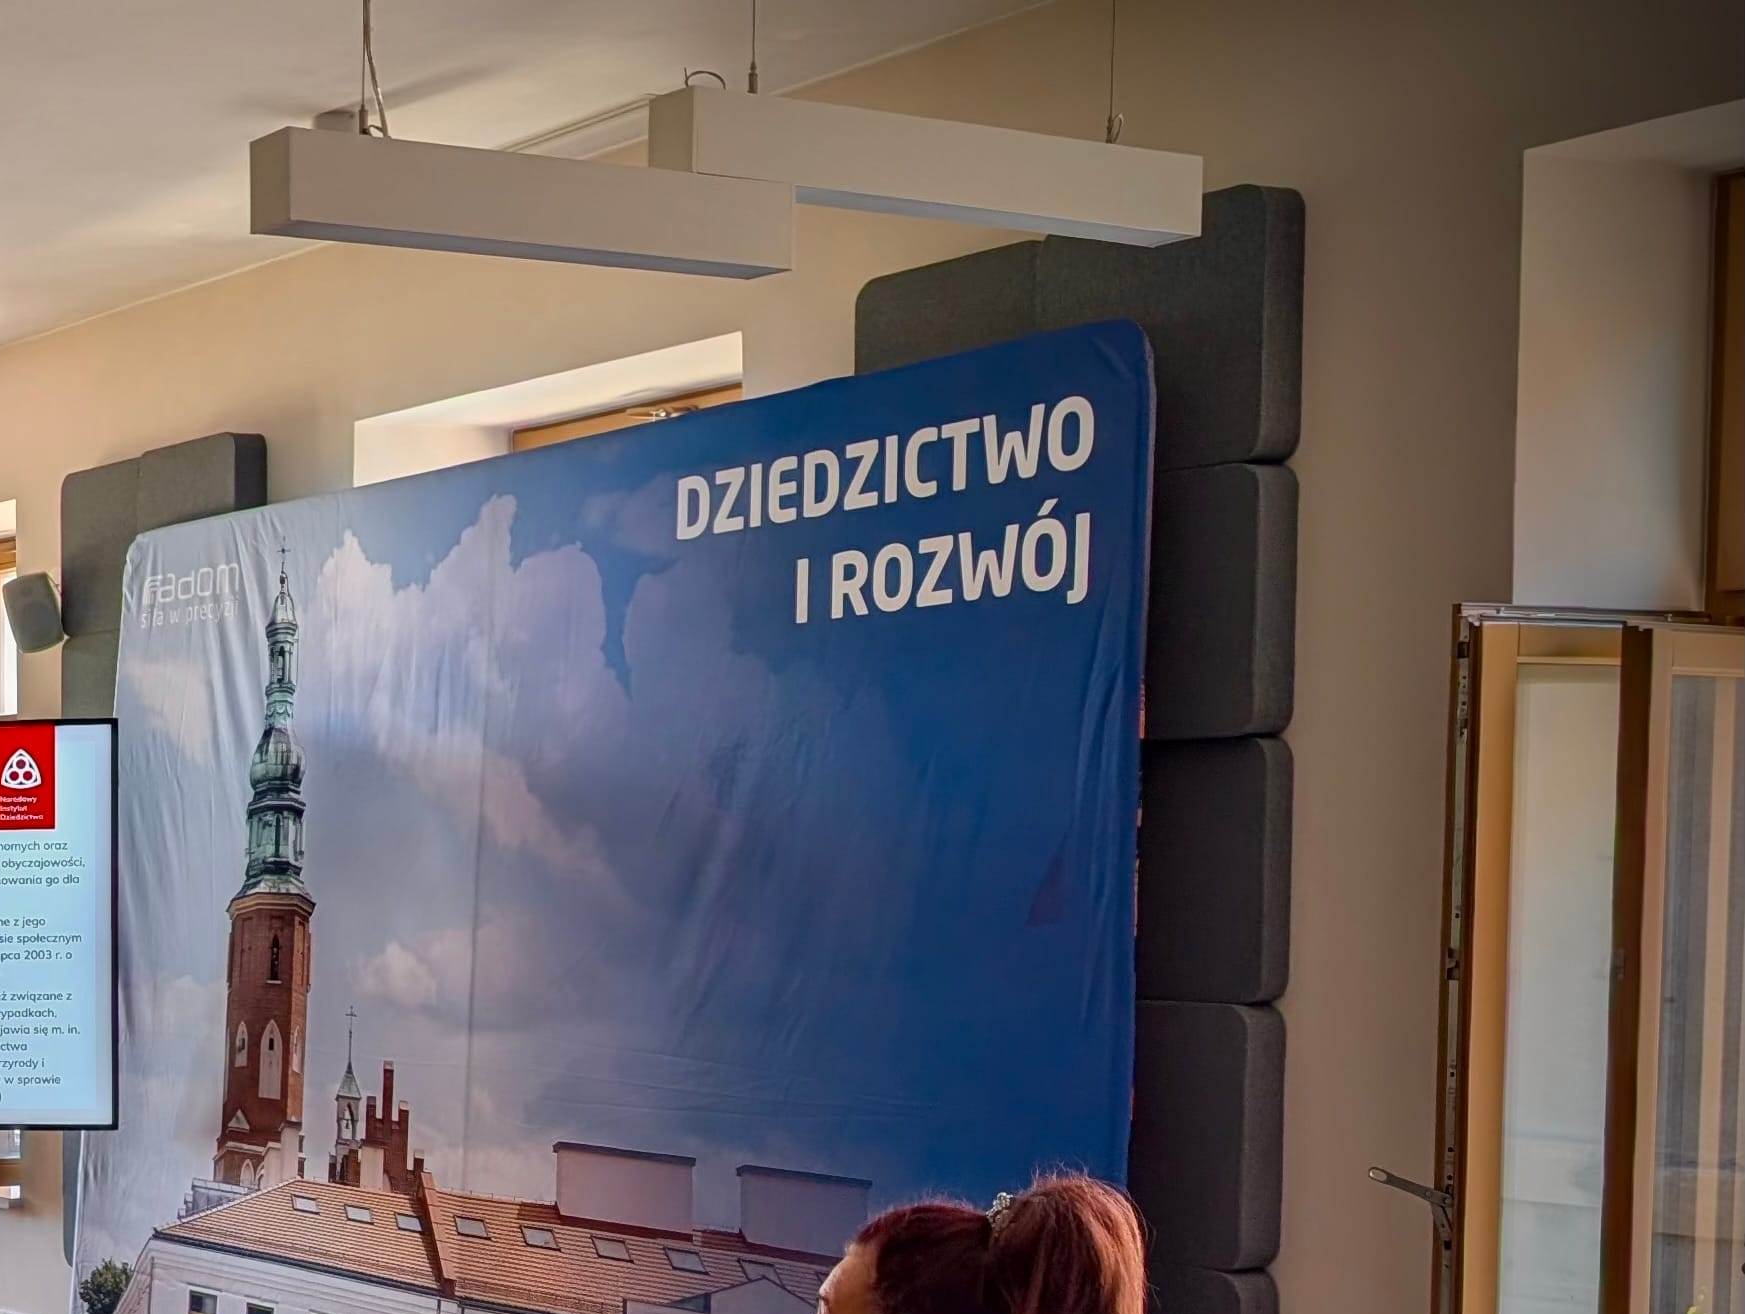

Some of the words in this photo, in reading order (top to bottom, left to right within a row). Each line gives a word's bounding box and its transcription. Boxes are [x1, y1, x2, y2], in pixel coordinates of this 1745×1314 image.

[675, 395, 1095, 541] DZIEDZICTWO
[794, 558, 809, 624] I
[830, 498, 1091, 620] ROZWÓJ
[23, 950, 52, 960] 2003
[17, 1073, 61, 1086] sprawie
